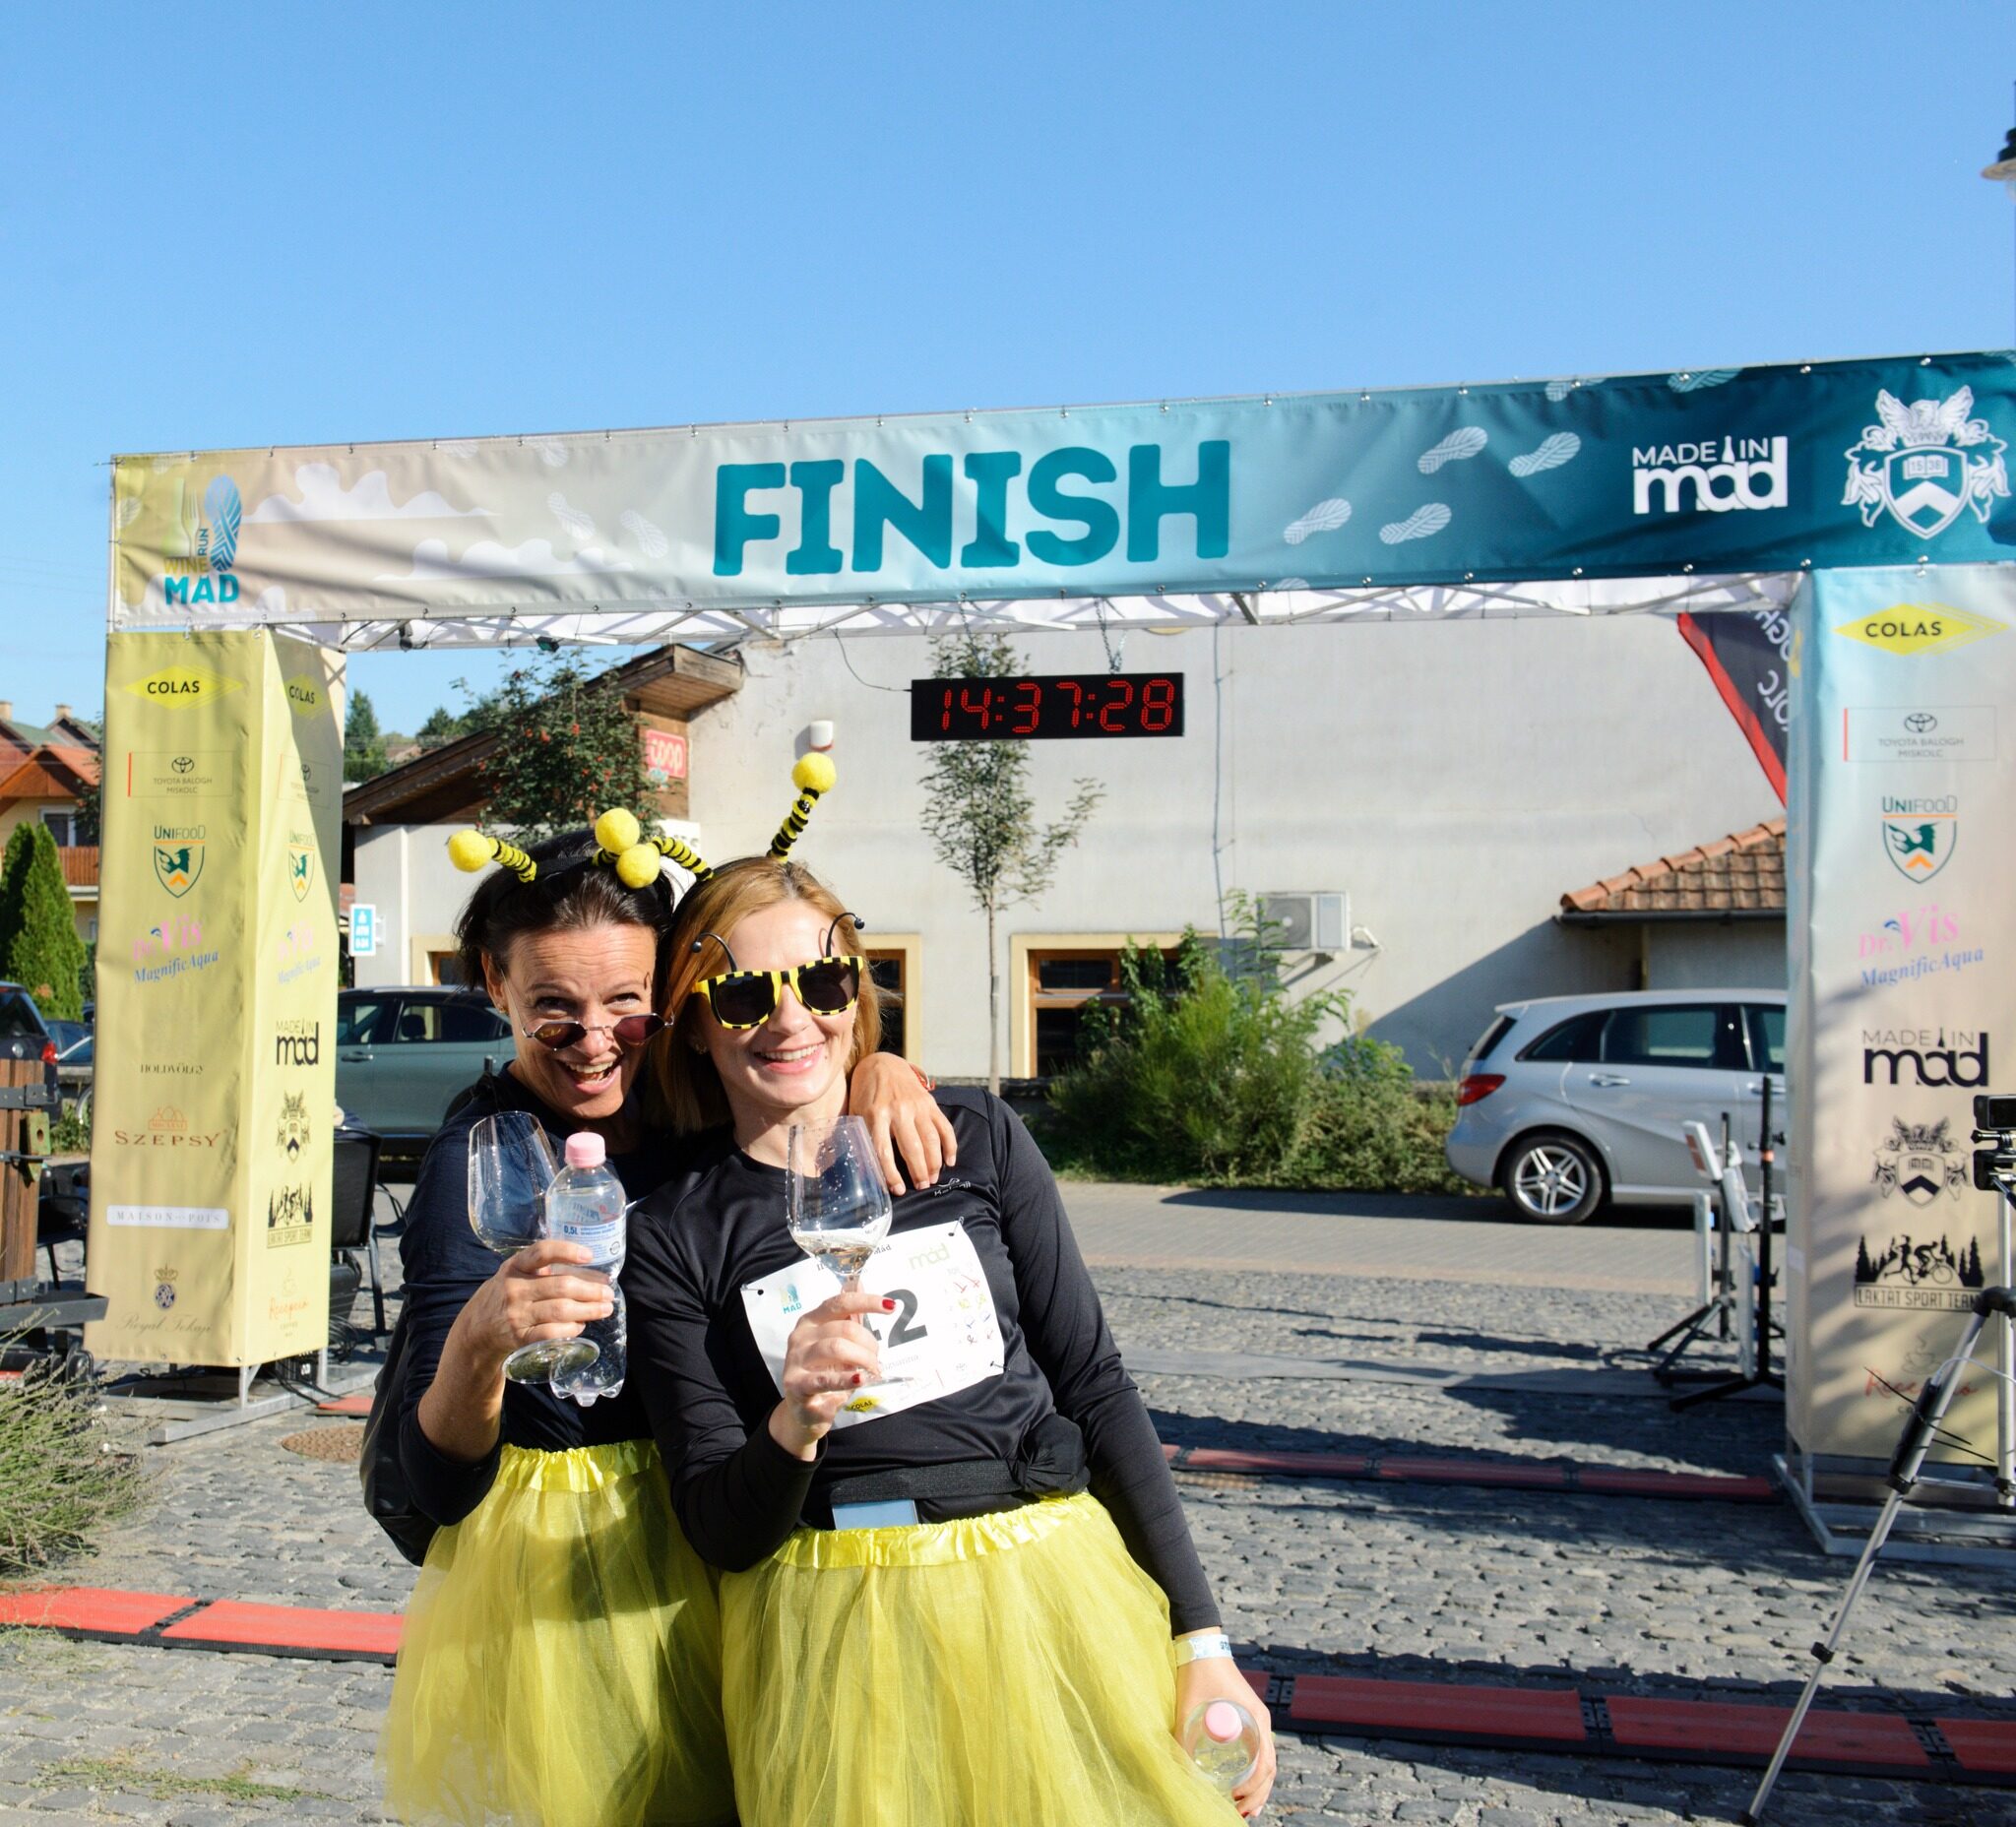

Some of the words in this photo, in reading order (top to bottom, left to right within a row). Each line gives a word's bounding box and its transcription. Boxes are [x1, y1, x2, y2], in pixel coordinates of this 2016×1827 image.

[1632, 440, 1718, 467] MADE
[1739, 437, 1768, 459] IN
[713, 440, 1230, 576] FINISH
[198, 528, 209, 556] RUN
[164, 556, 209, 573] WINE
[164, 574, 239, 605] MAD
[1865, 621, 1942, 637] COLAS
[147, 680, 200, 694] COLAS
[288, 685, 315, 705] COLAS
[941, 678, 1174, 733] 14:37:28
[1878, 738, 1918, 747] TOYOTA
[1921, 737, 1964, 747] BALOGH
[1898, 749, 1943, 758] MISKOLC
[182, 777, 213, 786] BALOGH
[277, 1020, 299, 1034] MADE
[306, 1021, 314, 1033] IN
[1863, 1030, 1931, 1045] MADE
[1953, 1032, 1975, 1046] IN
[115, 1130, 220, 1148] SZEPSY
[116, 1211, 173, 1222] MAISON
[1905, 1291, 1943, 1307] SPORT
[783, 1302, 802, 1314] MAD
[865, 1289, 928, 1348] 2
[850, 1400, 873, 1411] COLAS
